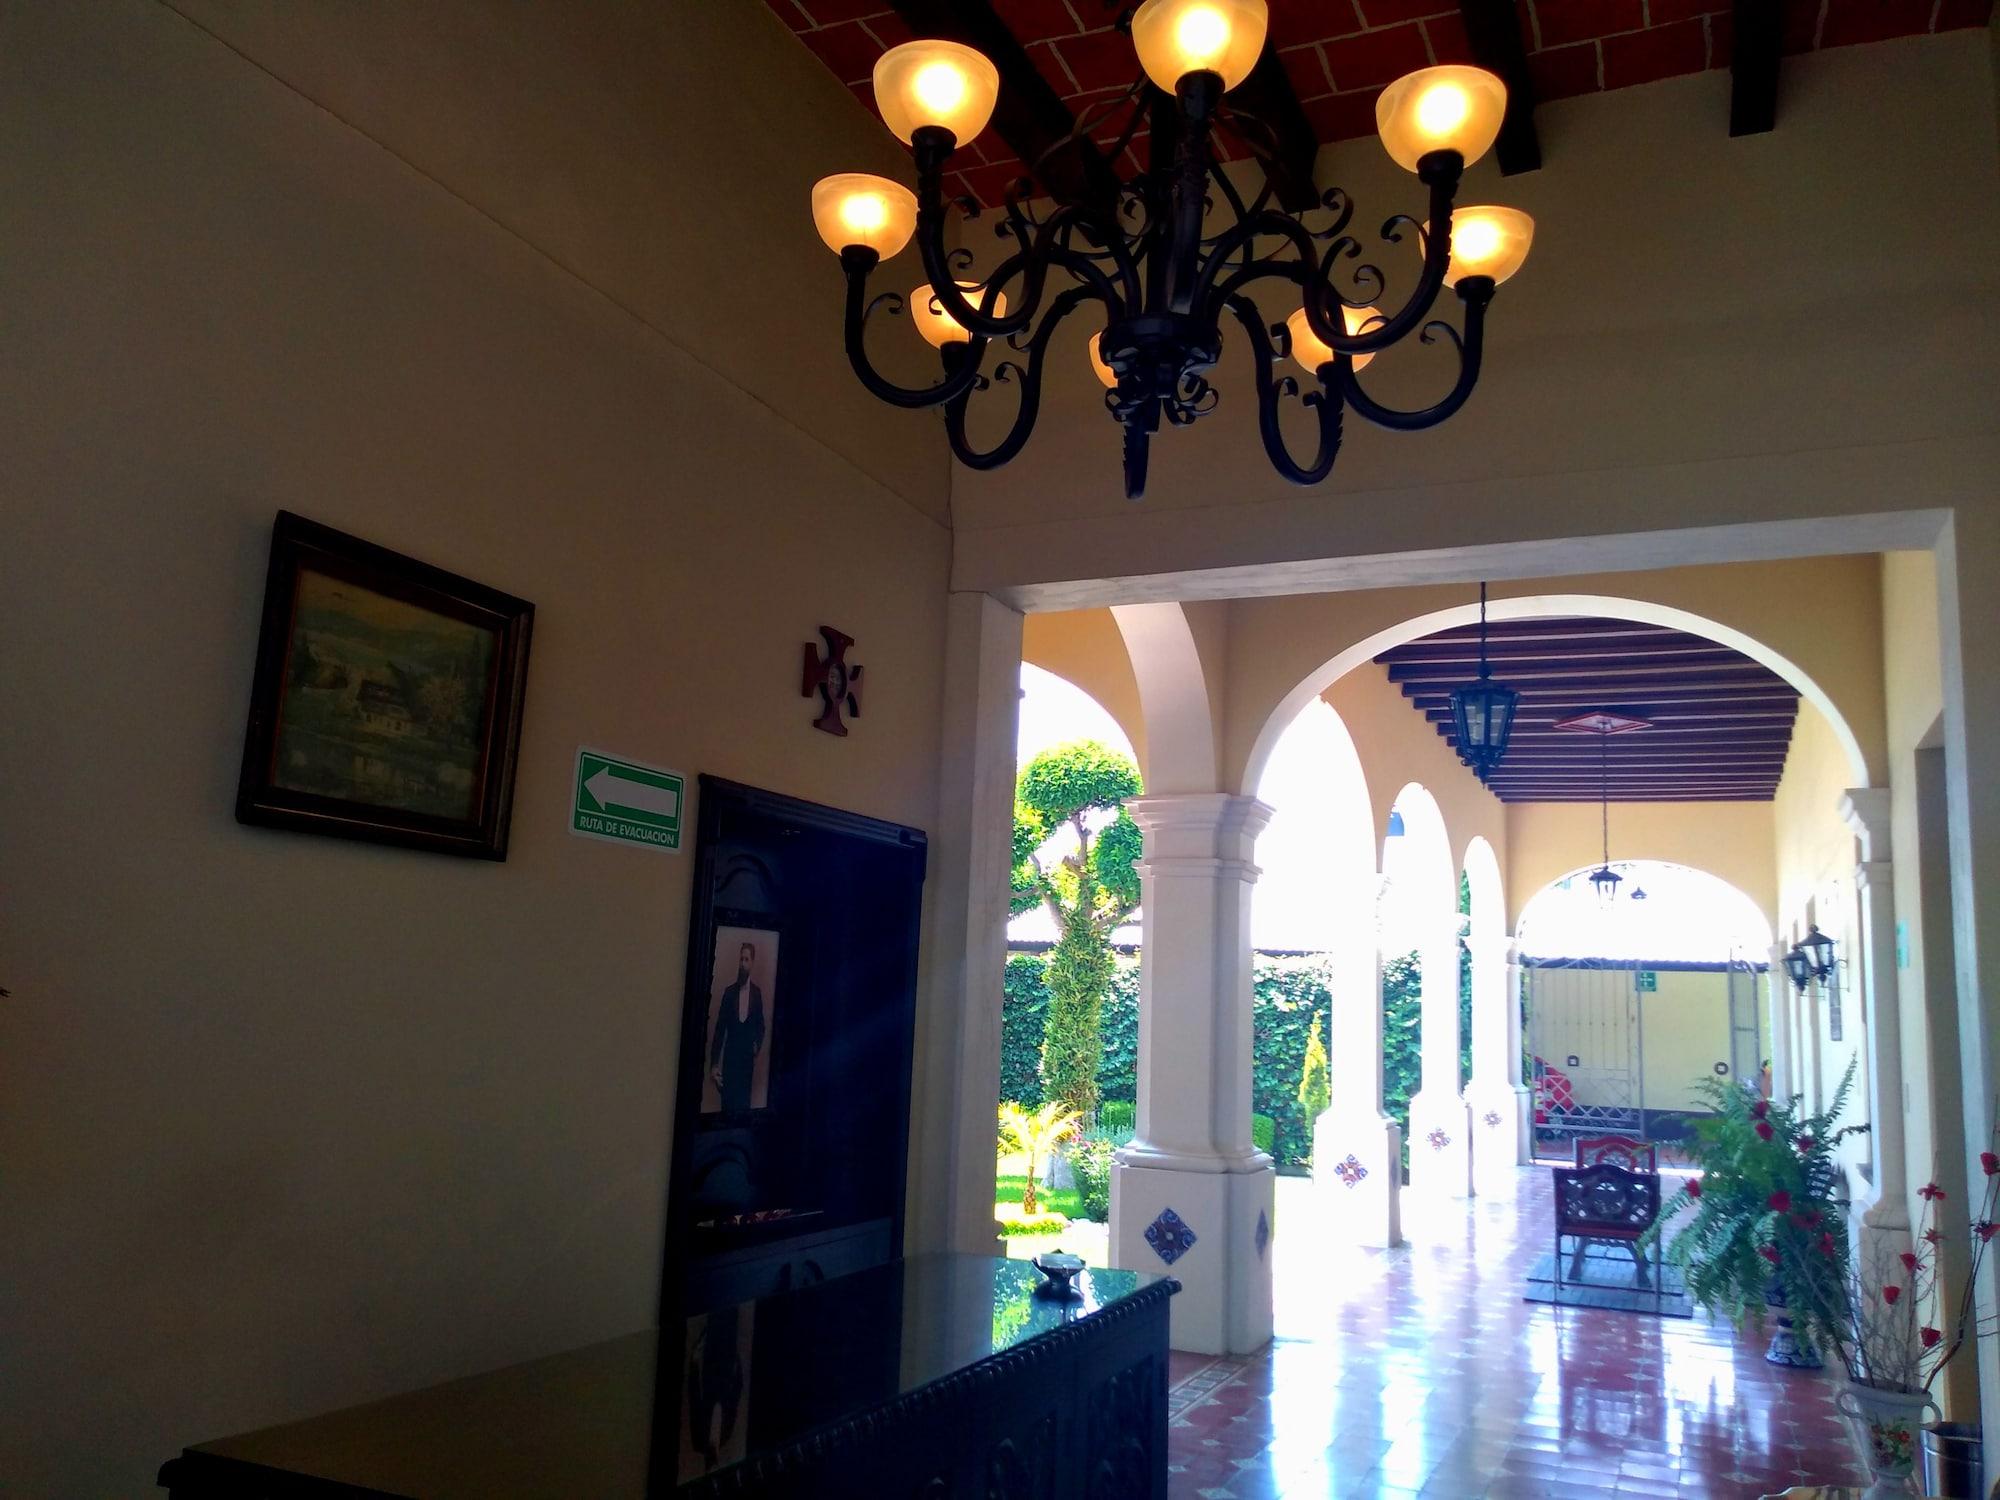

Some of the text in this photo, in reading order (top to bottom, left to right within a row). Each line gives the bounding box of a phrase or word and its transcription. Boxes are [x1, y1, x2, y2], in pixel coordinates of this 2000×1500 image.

[580, 816, 674, 844] RUTA DE EVACUACION
